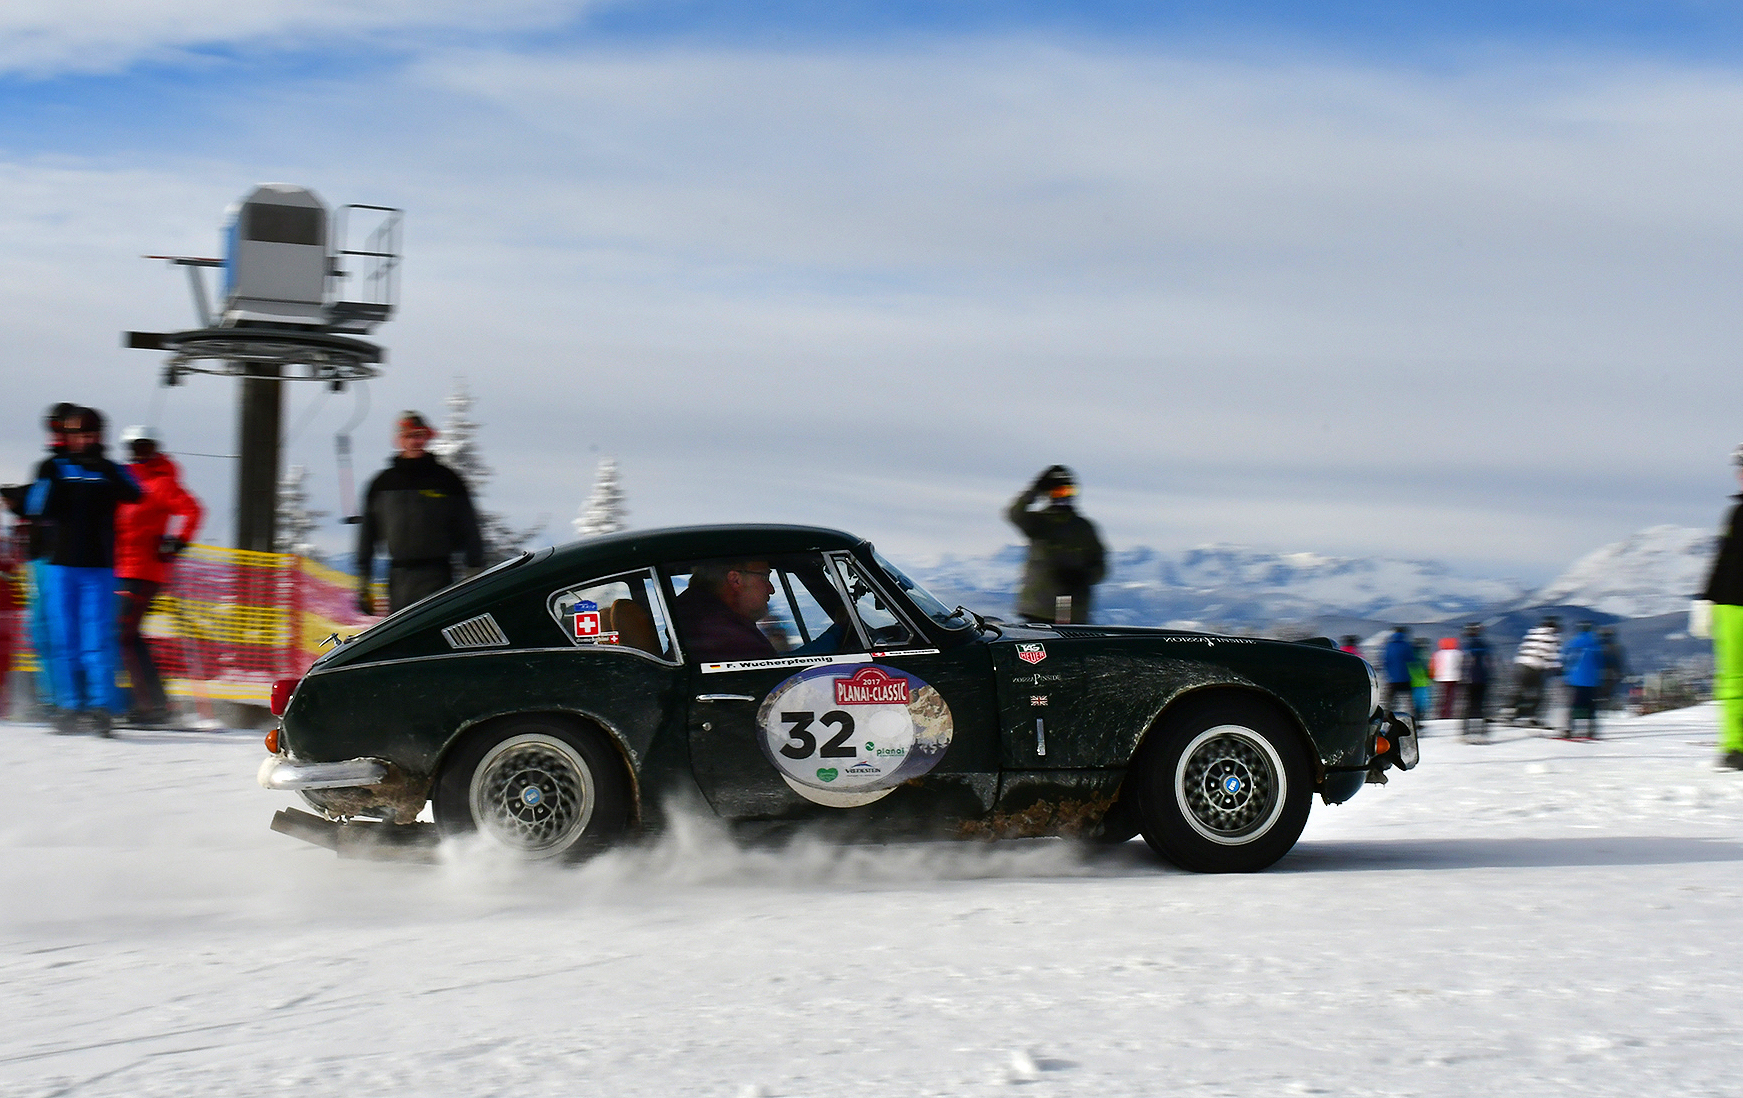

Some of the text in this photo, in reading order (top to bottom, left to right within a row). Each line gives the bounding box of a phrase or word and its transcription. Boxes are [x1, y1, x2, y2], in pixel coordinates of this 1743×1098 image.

[1020, 643, 1041, 652] TAG
[739, 656, 834, 668] Wucherpfennig
[1019, 651, 1046, 663] HEUER
[862, 678, 881, 686] 2017
[837, 681, 907, 702] PLANAI-CLASSIC
[779, 710, 857, 760] 32
[876, 747, 905, 757] planai
